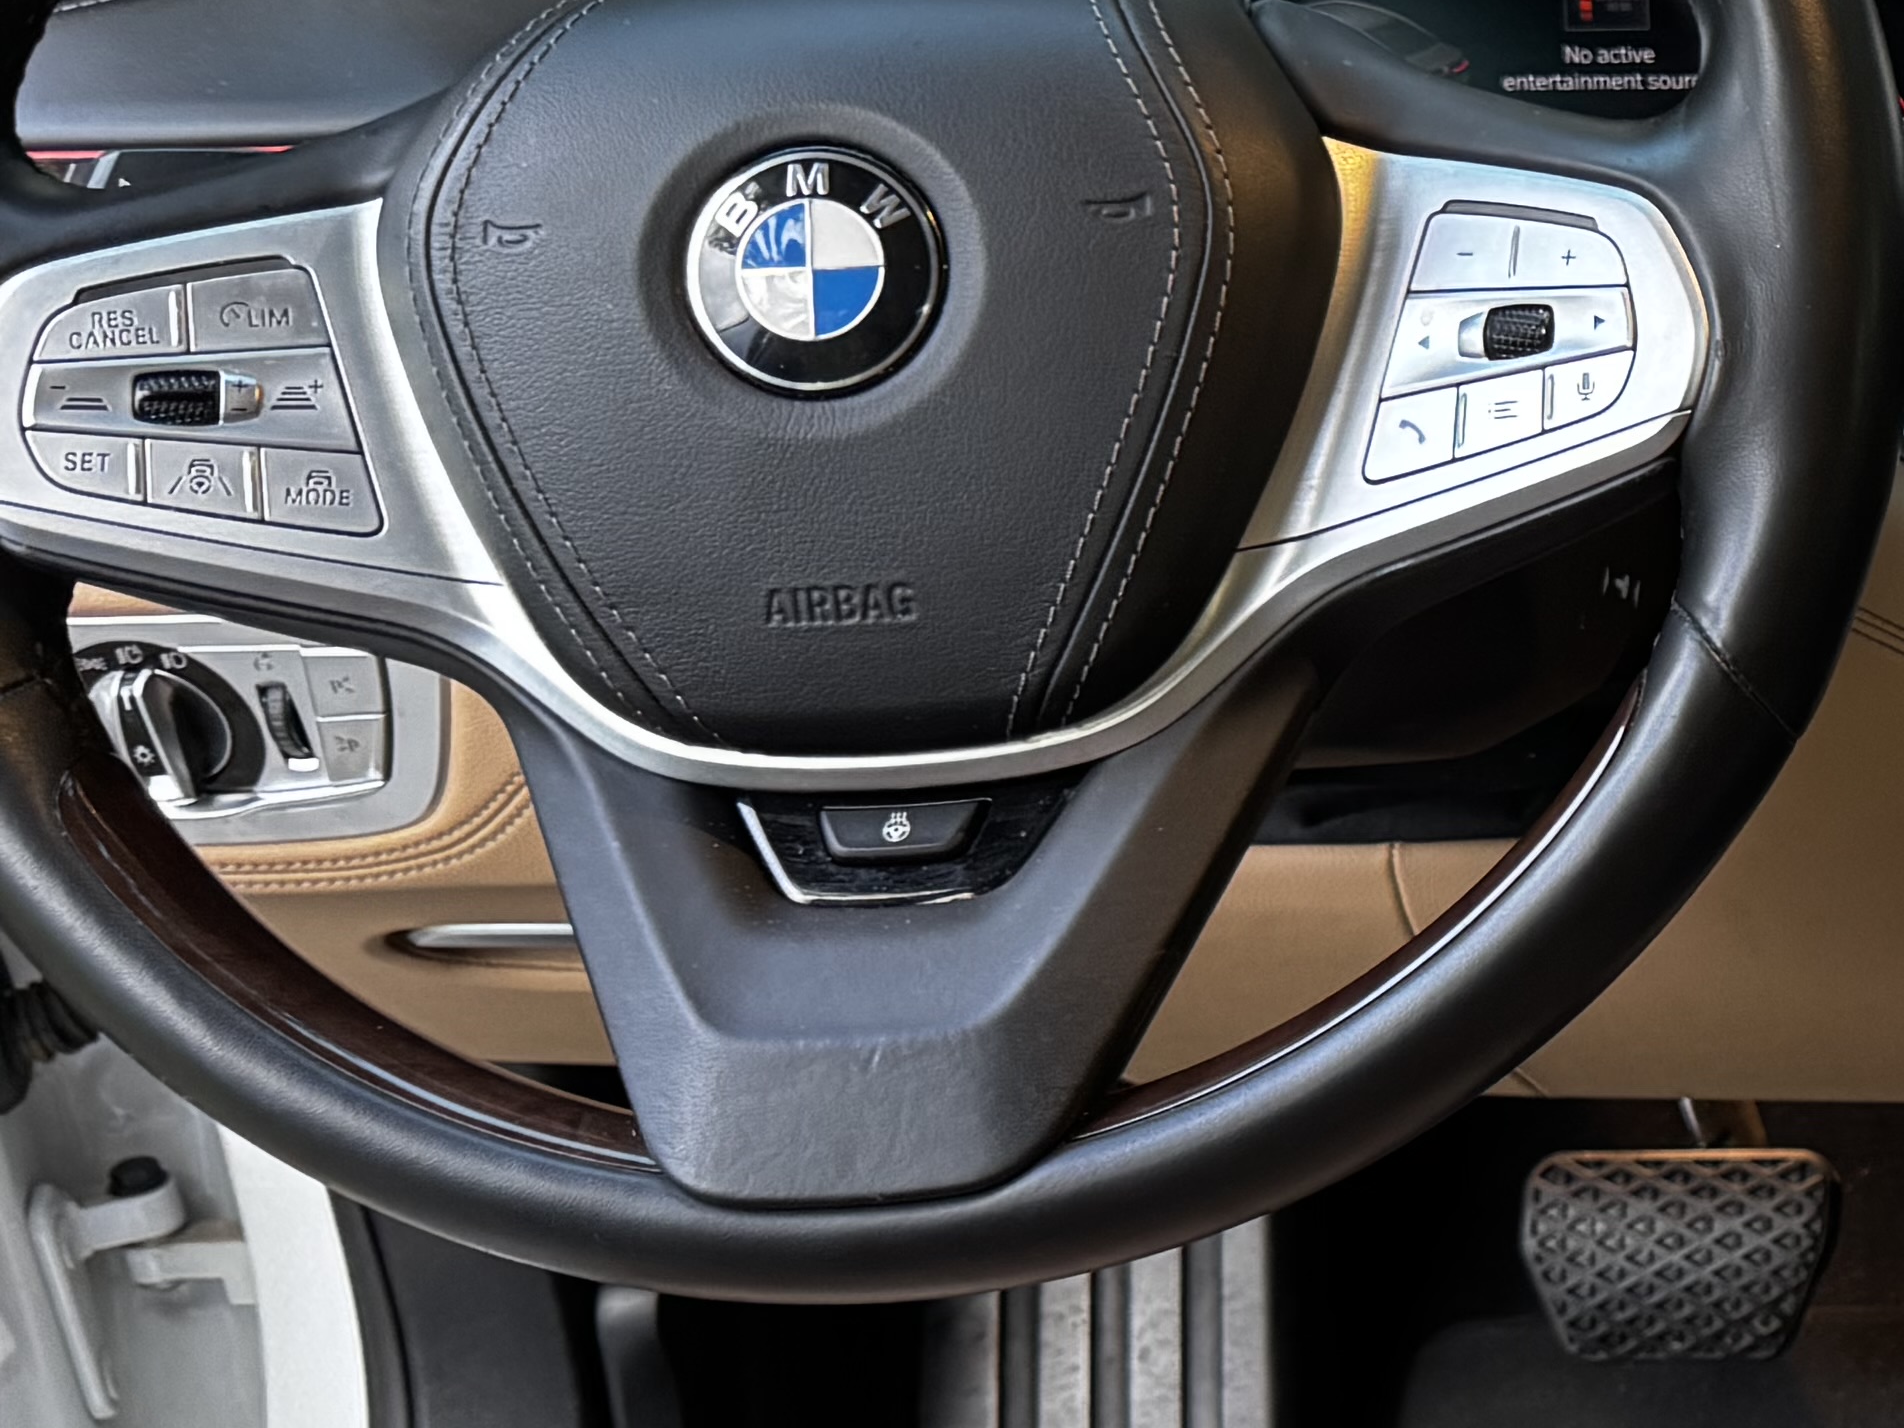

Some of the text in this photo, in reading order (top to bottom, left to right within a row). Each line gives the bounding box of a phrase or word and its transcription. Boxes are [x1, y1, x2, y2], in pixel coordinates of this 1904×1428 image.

[1562, 44, 1656, 64] No active
[1502, 73, 1645, 91] entertainment
[714, 161, 912, 239] BMW
[91, 310, 135, 328] RES
[248, 307, 291, 328] LIM
[68, 328, 161, 350] CANCEL
[64, 452, 111, 472] SET
[284, 487, 353, 507] MODE
[765, 581, 919, 627] AIRBAG
